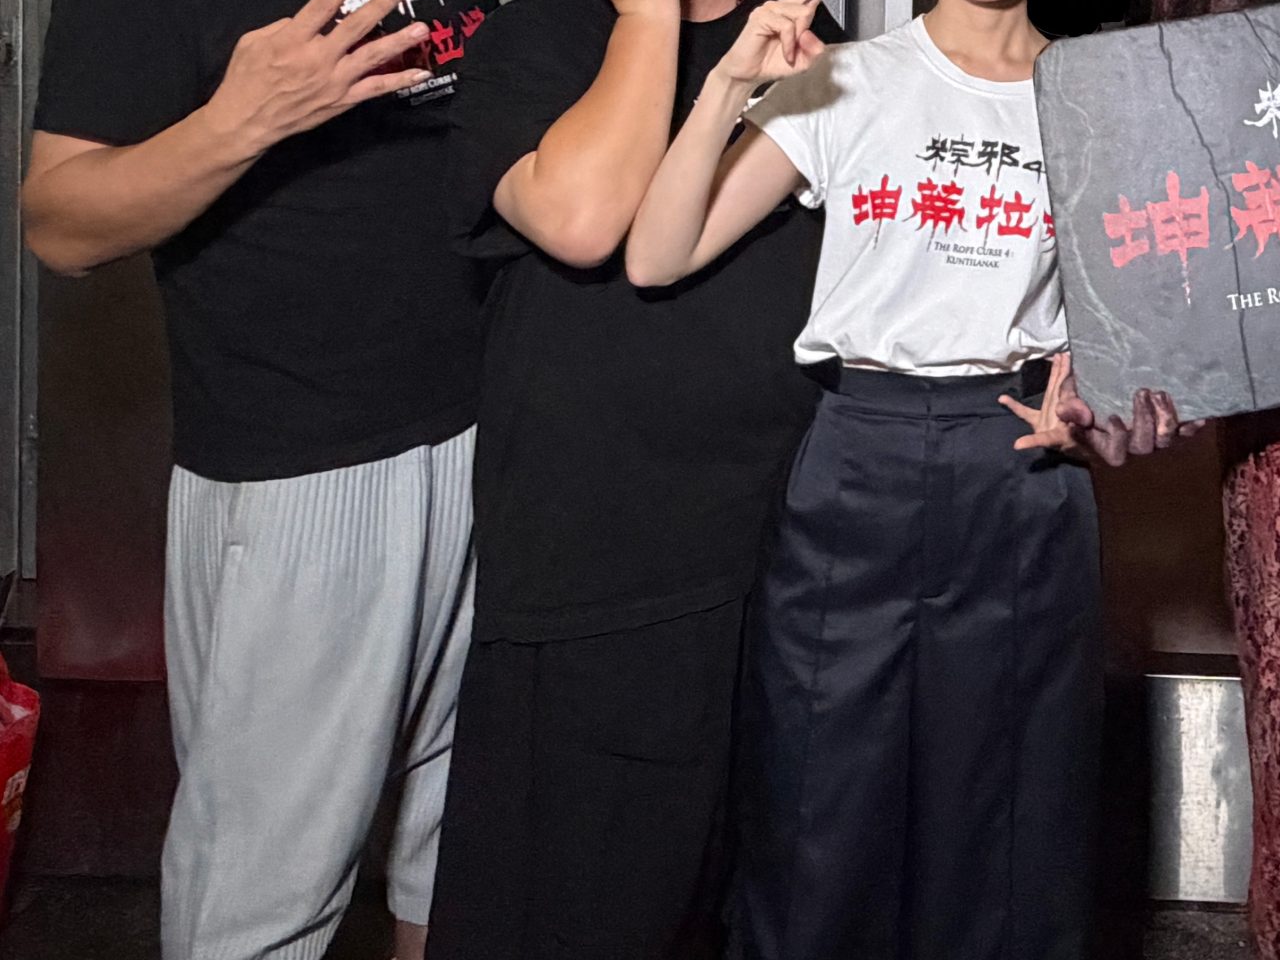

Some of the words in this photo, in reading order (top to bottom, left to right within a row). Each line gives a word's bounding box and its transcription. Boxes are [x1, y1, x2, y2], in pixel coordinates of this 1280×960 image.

[852, 174, 1056, 244] 坤蒂拉
[934, 241, 951, 252] THE
[952, 243, 975, 255] ROPE
[976, 246, 1003, 257] CURSE
[946, 255, 1000, 268] KUNTILANAK
[1227, 292, 1263, 311] THE
